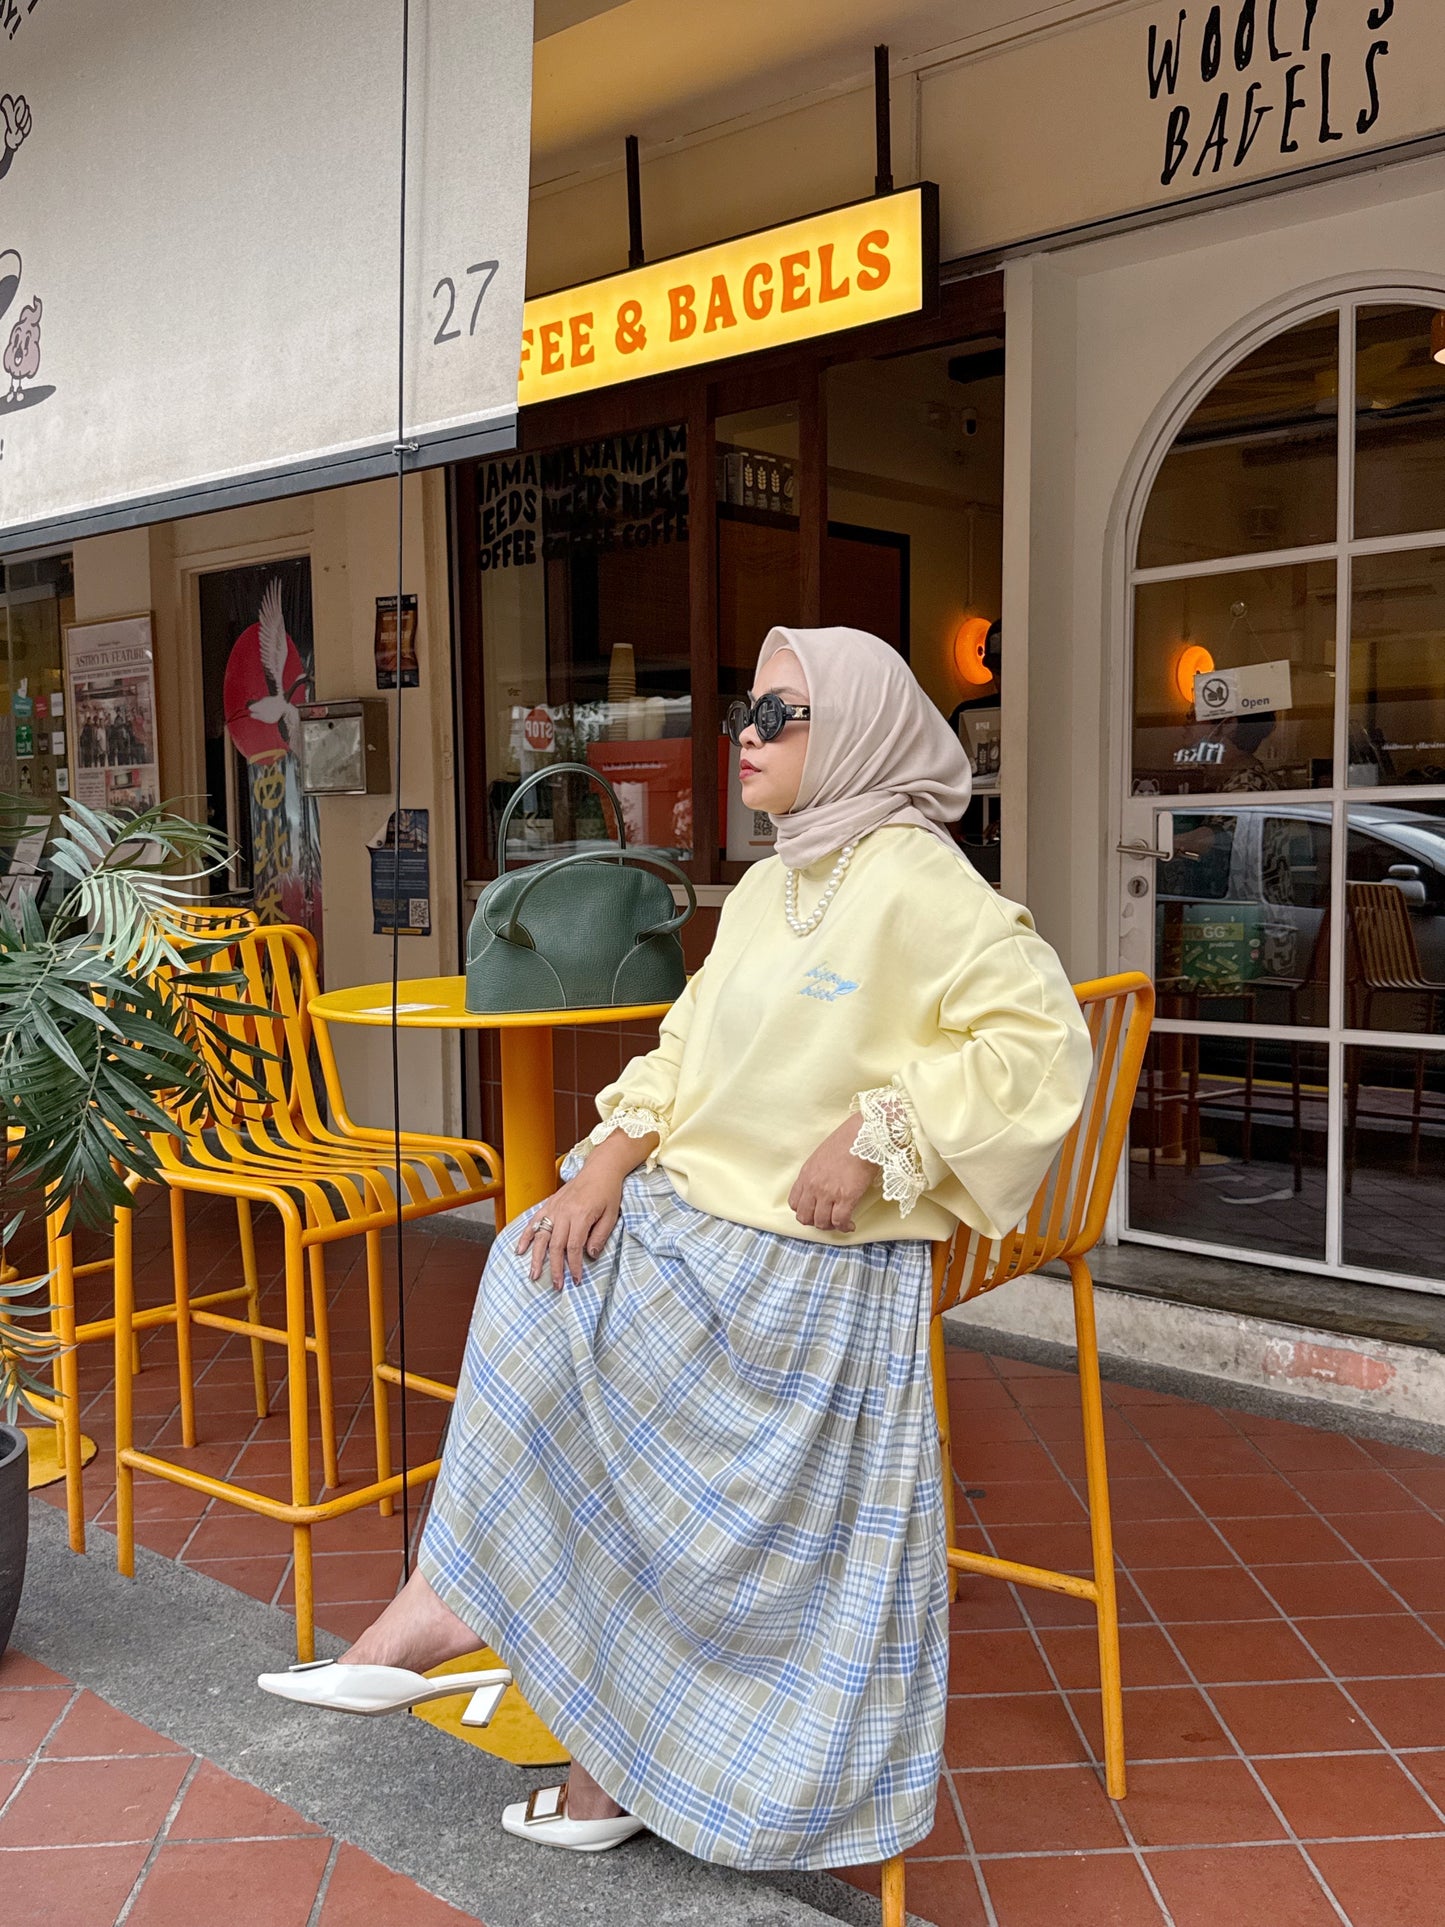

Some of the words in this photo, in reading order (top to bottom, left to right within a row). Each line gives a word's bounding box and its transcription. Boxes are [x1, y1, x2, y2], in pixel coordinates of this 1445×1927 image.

[1160, 40, 1389, 185] BAGELS
[432, 260, 500, 345] 27
[615, 300, 648, 356] &
[668, 229, 892, 343] BAGELS
[1241, 697, 1270, 709] Open
